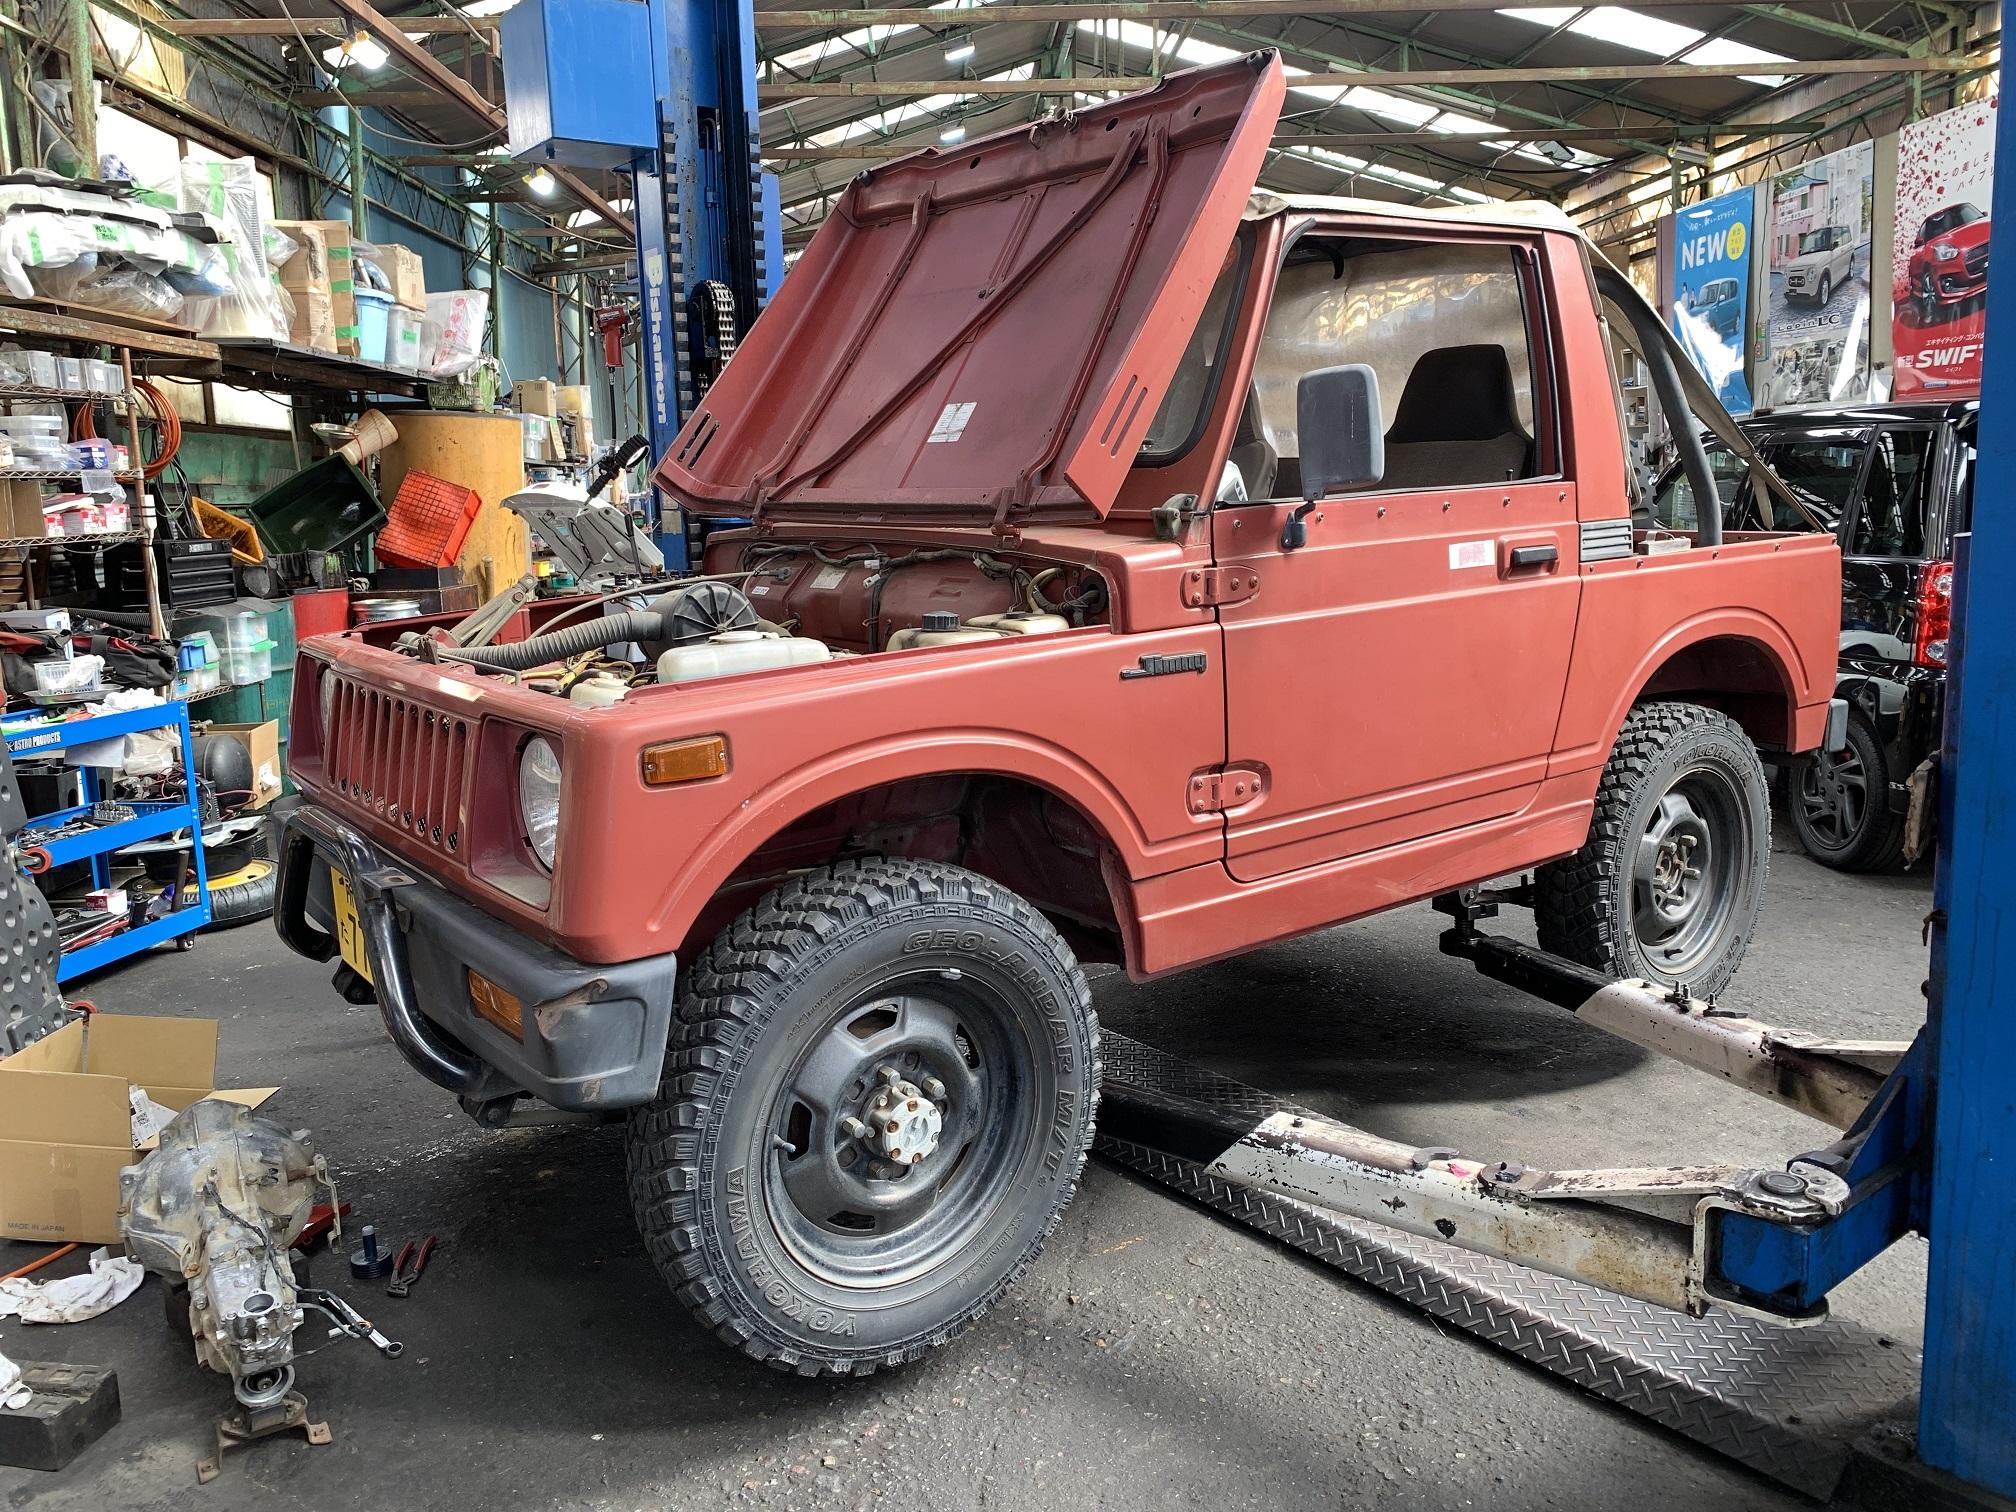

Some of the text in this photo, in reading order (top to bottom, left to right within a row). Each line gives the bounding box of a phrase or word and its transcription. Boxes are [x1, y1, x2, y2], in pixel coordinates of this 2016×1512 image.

[1681, 229, 1727, 271] NEW
[644, 249, 667, 425] Bishamon
[33, 731, 61, 748] PRODUCTS
[903, 928, 1075, 1074] GEOLANDAR
[8, 1222, 30, 1230] MADE
[42, 1224, 64, 1232] JAPAN
[726, 1165, 857, 1337] YOKOHAMA
